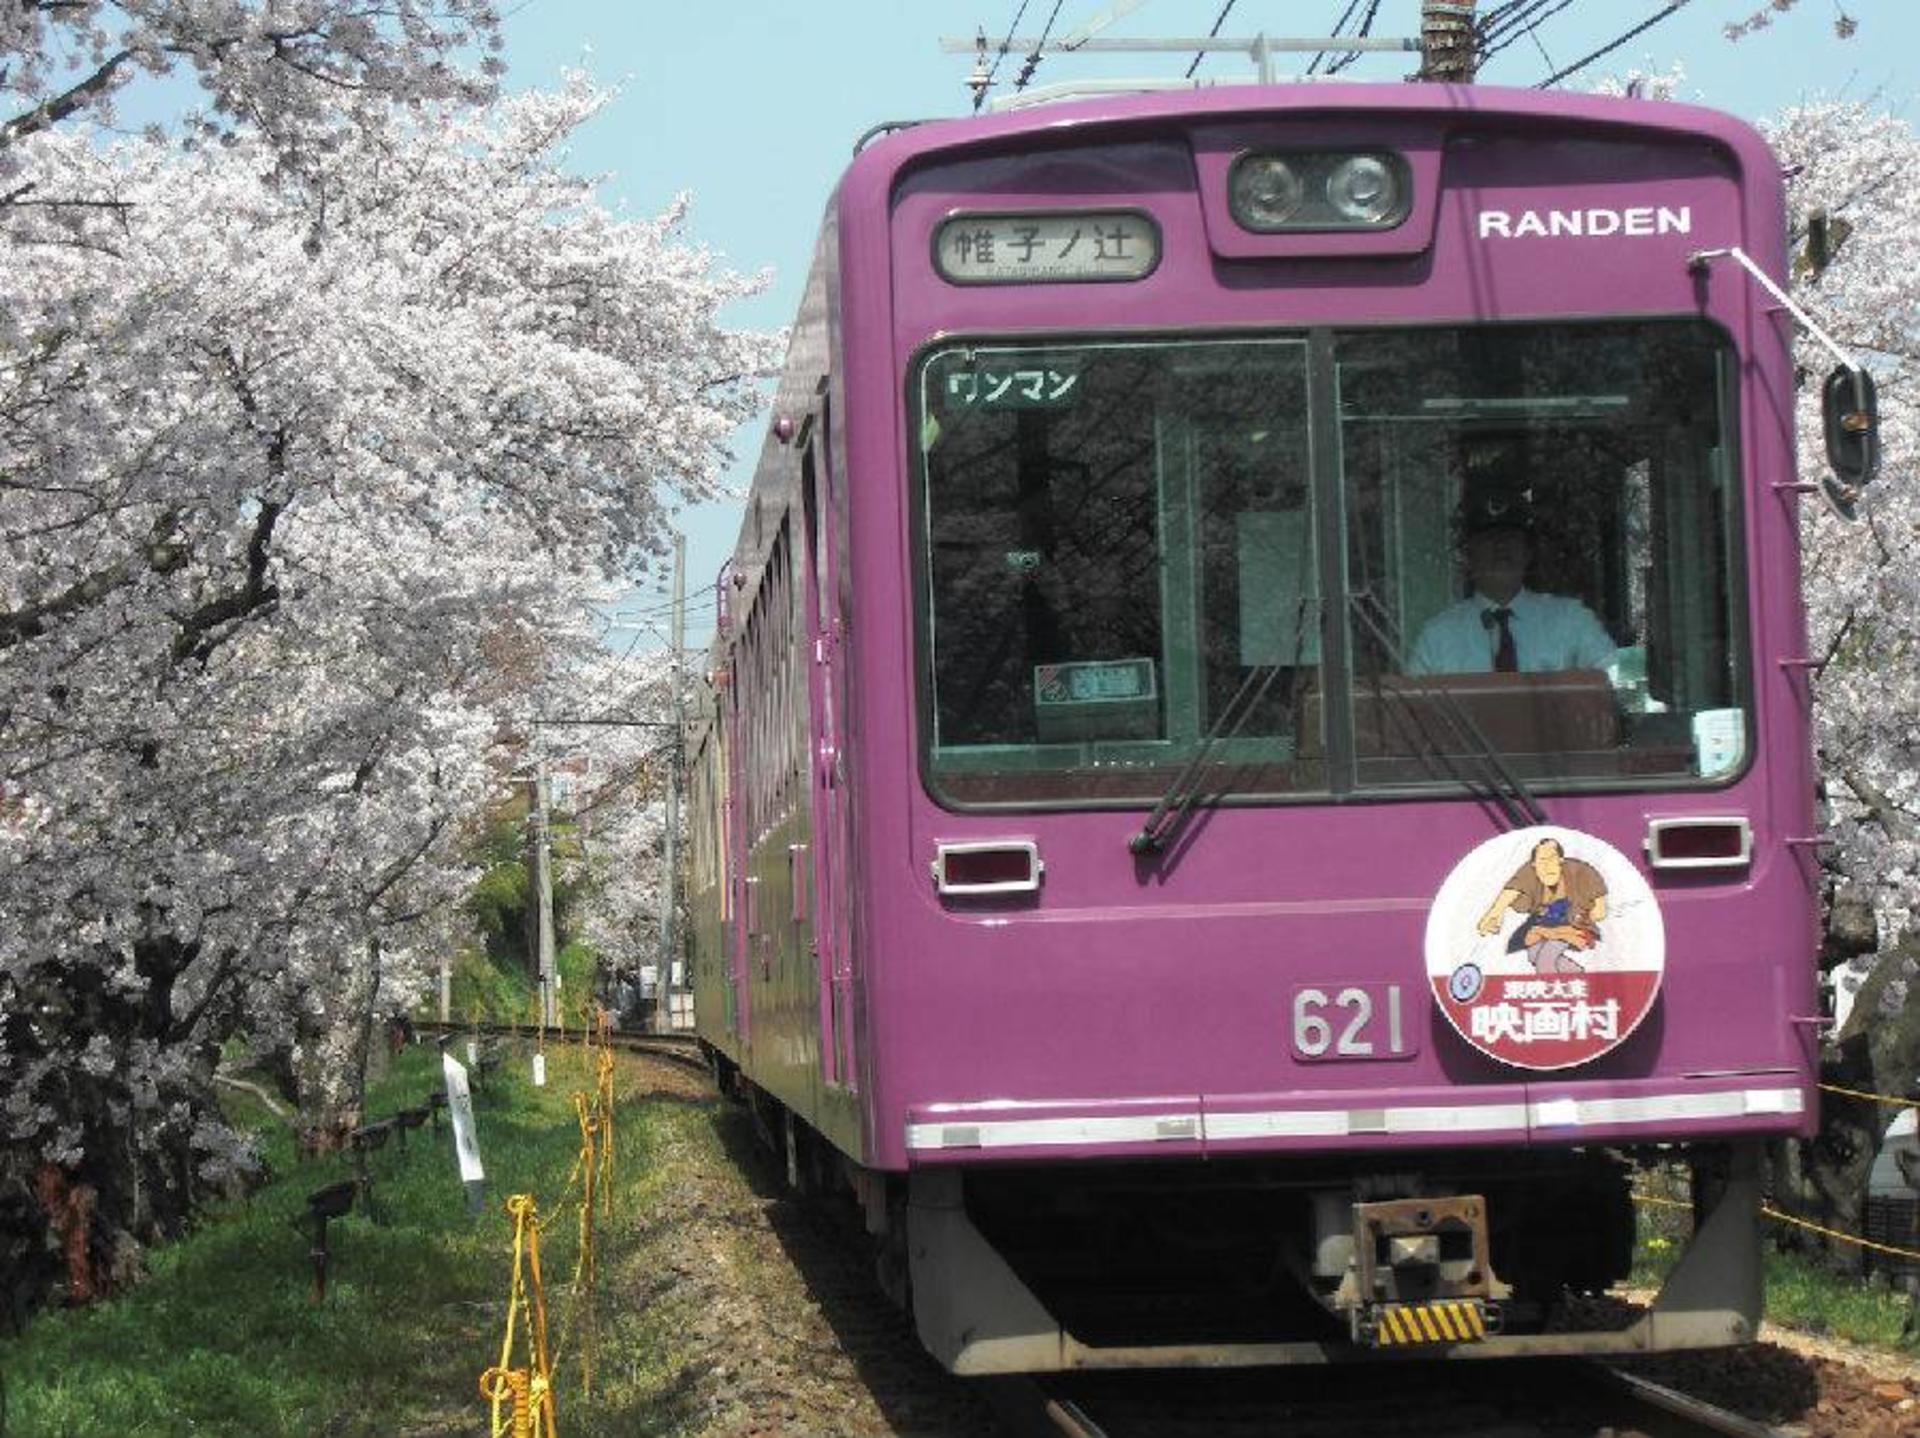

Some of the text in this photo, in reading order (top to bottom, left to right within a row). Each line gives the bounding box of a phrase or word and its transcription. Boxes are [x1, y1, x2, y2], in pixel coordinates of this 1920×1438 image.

[1479, 206, 1692, 238] RANDEN
[948, 370, 1078, 403] ワンマン
[1294, 985, 1403, 1056] 621
[1470, 998, 1620, 1043] 映画村
